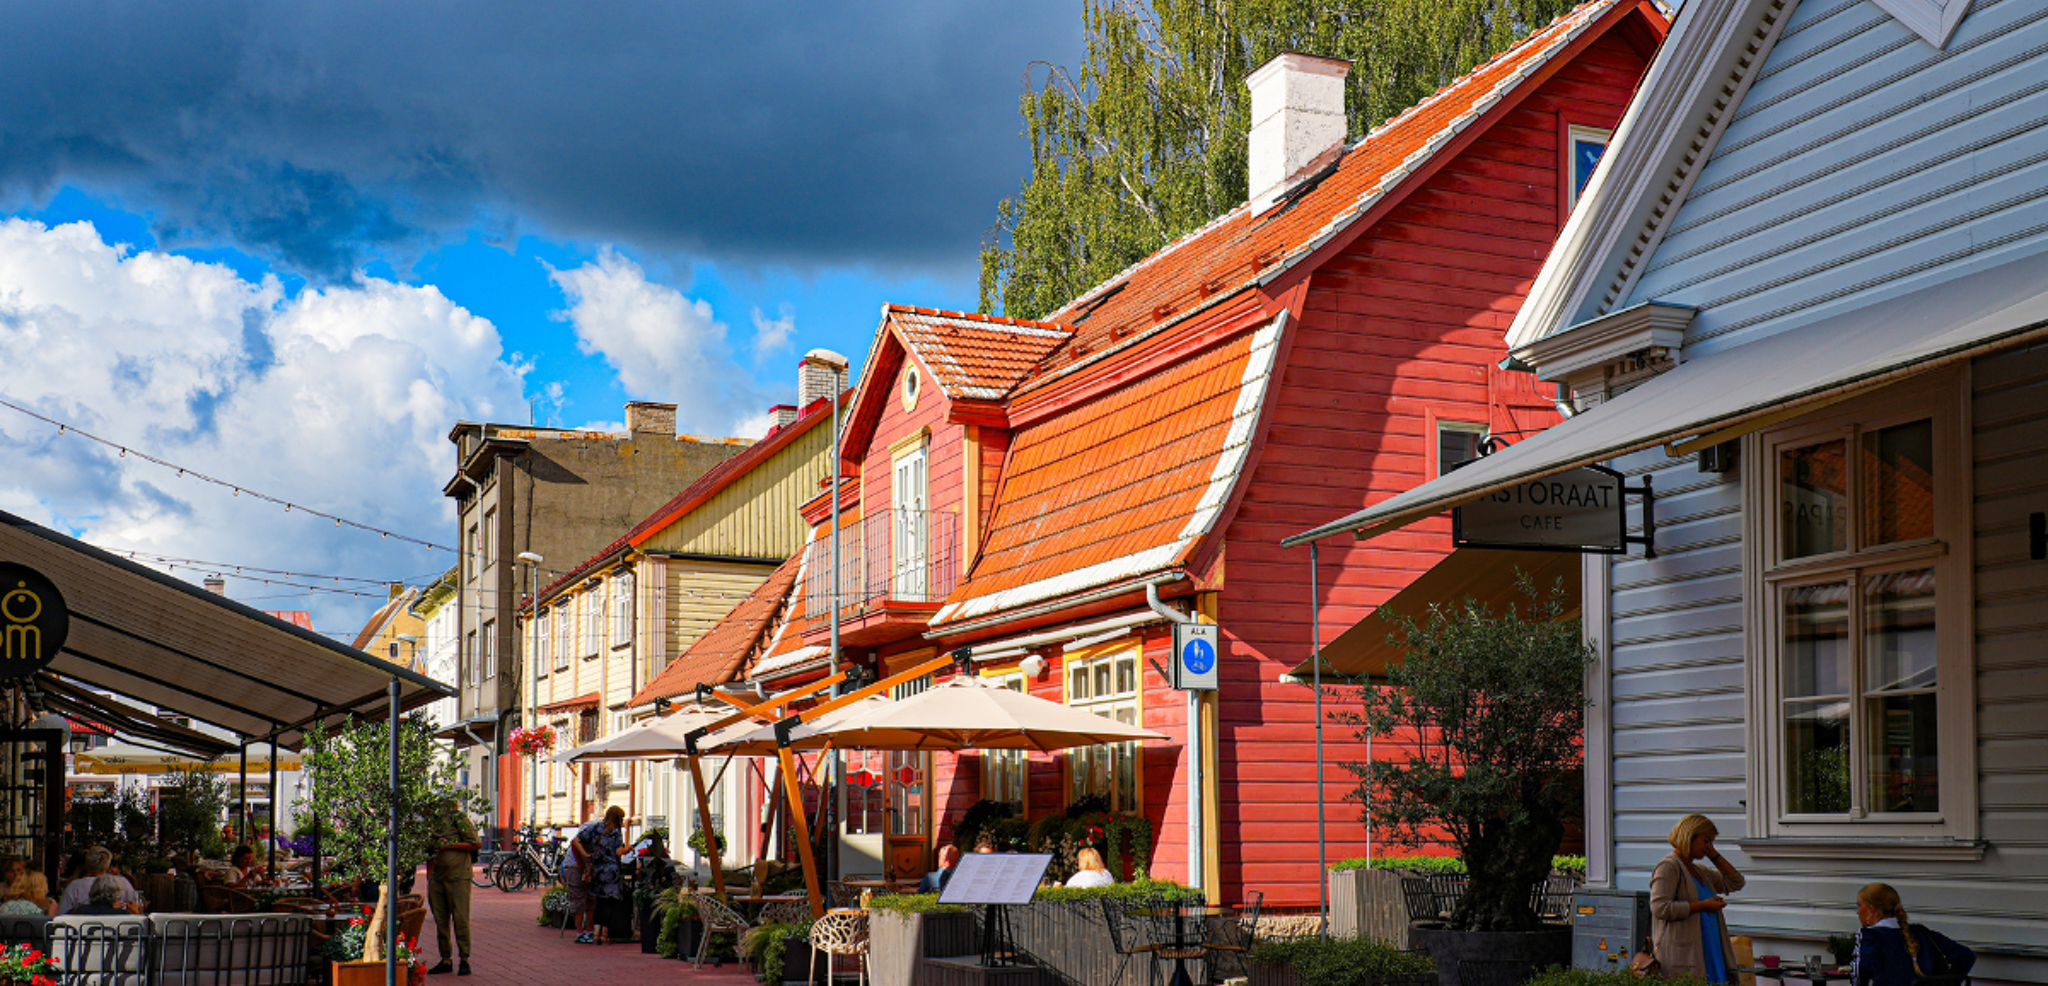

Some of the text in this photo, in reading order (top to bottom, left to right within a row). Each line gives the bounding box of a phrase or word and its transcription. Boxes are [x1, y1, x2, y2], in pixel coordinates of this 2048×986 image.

[1480, 481, 1613, 508] STORAAT
[1520, 514, 1563, 530] CAFE
[1191, 627, 1207, 635] ALA
